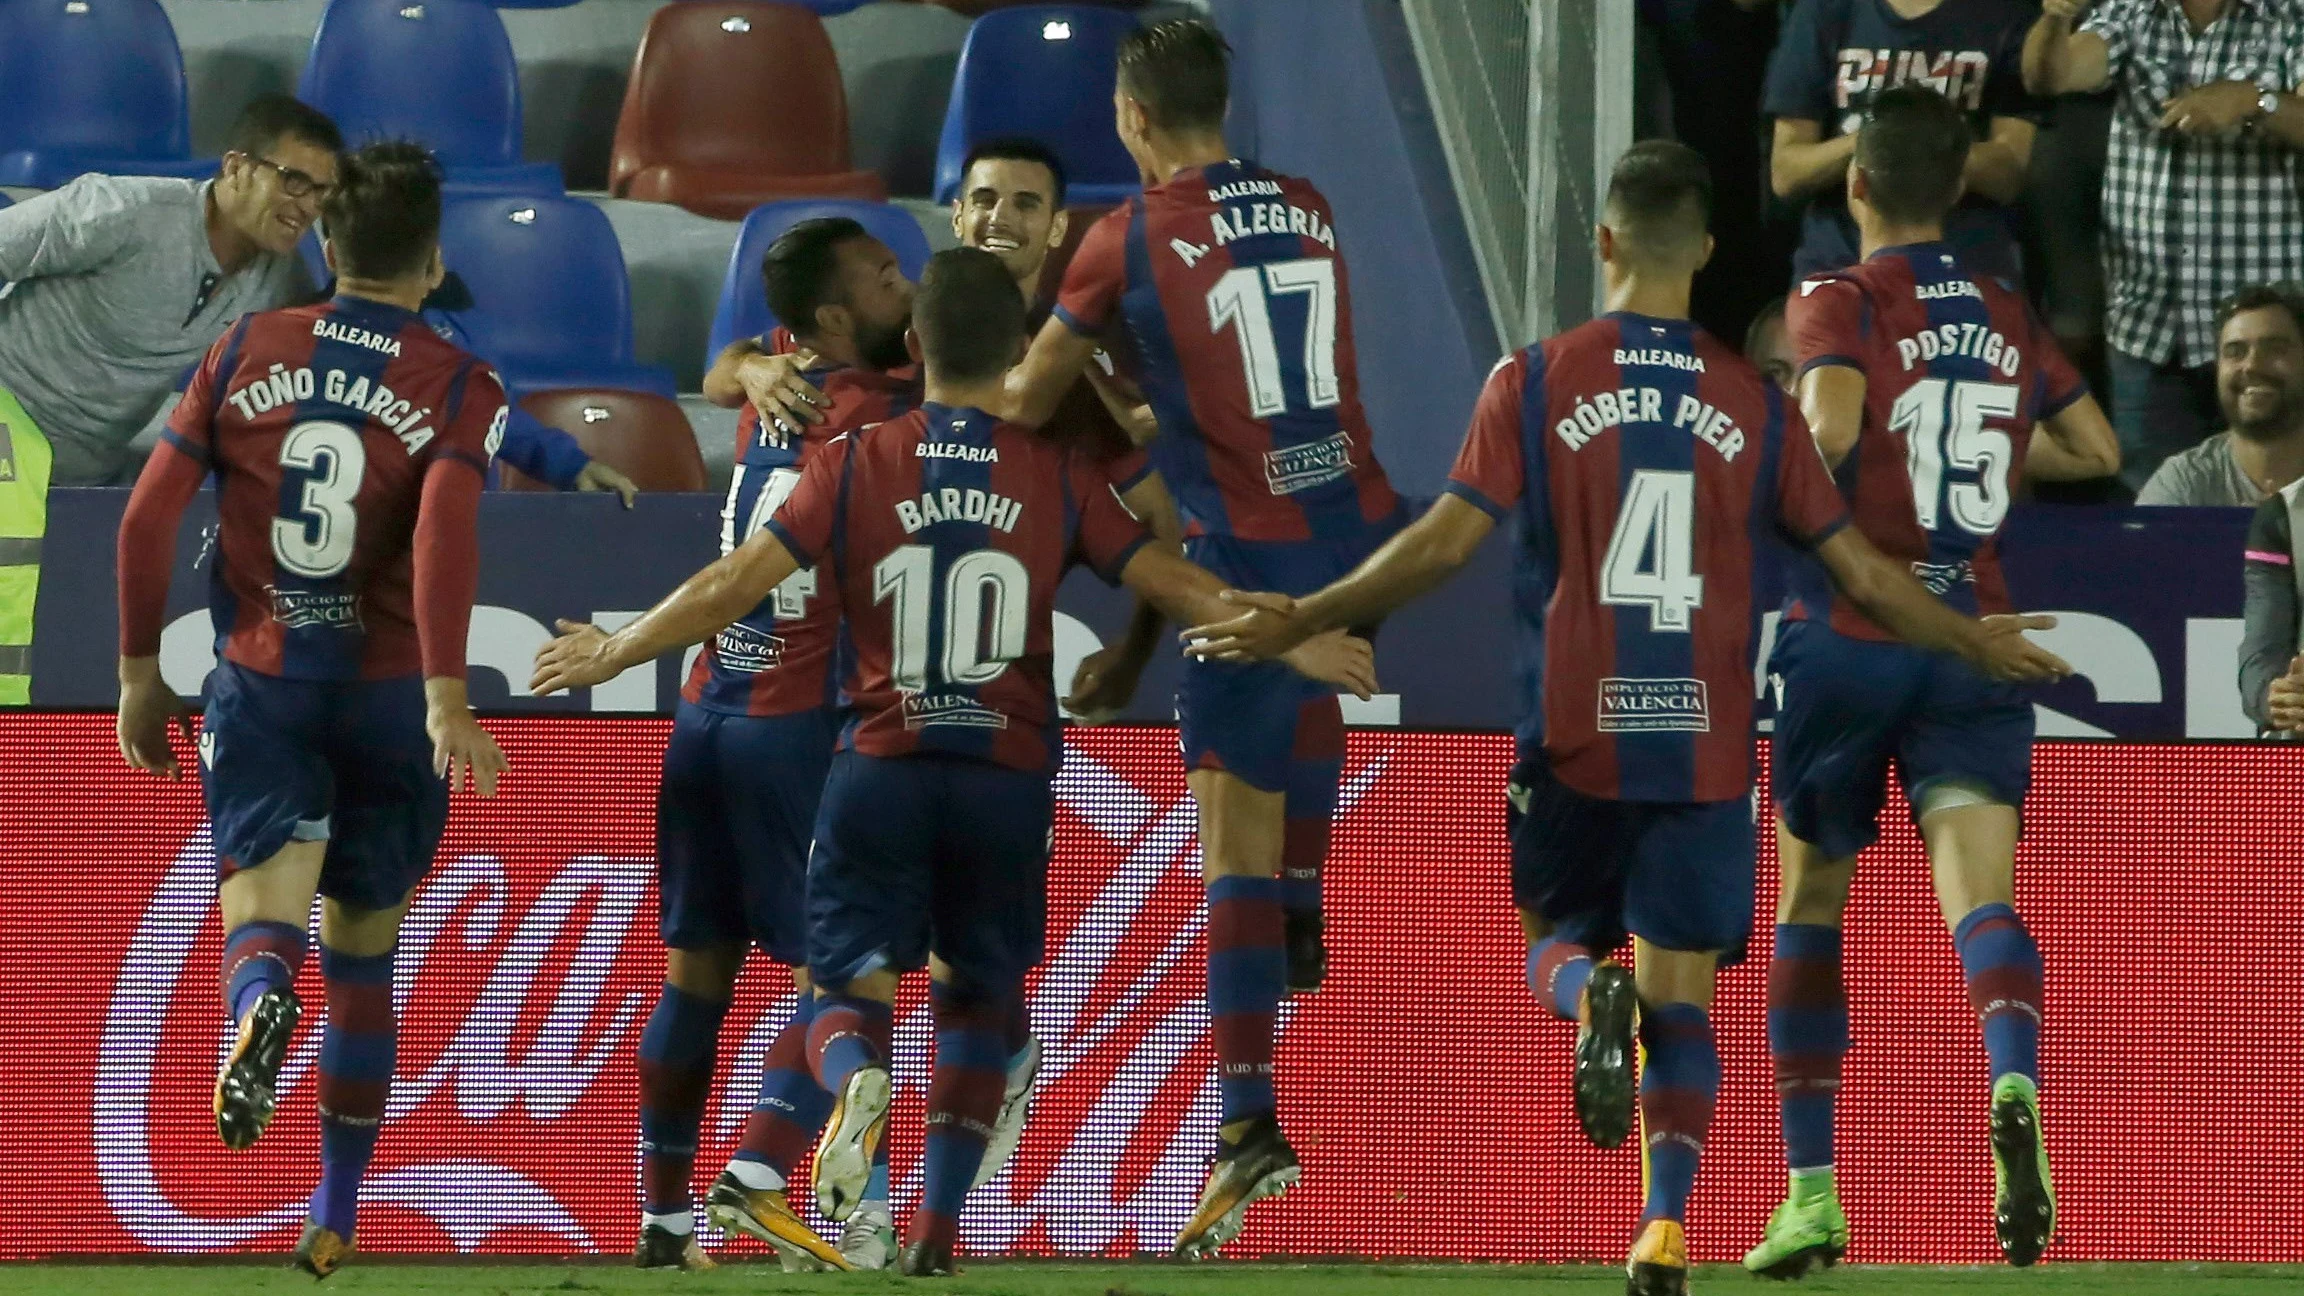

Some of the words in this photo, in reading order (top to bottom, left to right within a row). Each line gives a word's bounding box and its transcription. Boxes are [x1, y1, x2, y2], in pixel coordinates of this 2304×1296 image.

[1836, 48, 1989, 110] PUMA
[1208, 179, 1283, 202] BALEARIA
[1170, 237, 1210, 269] A.
[1210, 203, 1336, 251] ALEGRÍA
[312, 319, 402, 357] BALEARIA
[1205, 257, 1341, 419] 17
[1613, 349, 1706, 373] BALEARIA
[1897, 323, 2021, 377] POSTIGO
[229, 362, 315, 421] TOÑO
[324, 368, 435, 456] GARCÍA
[1555, 386, 1663, 452] RÓBER
[1672, 394, 1746, 463] PIER
[915, 443, 999, 463] BALEARIA
[1887, 378, 2021, 536] 15
[270, 418, 366, 578] 3
[895, 487, 1023, 535] BARDHI
[1599, 468, 1704, 633] 4
[872, 543, 1030, 694] 10
[1226, 1062, 1252, 1074] LUD
